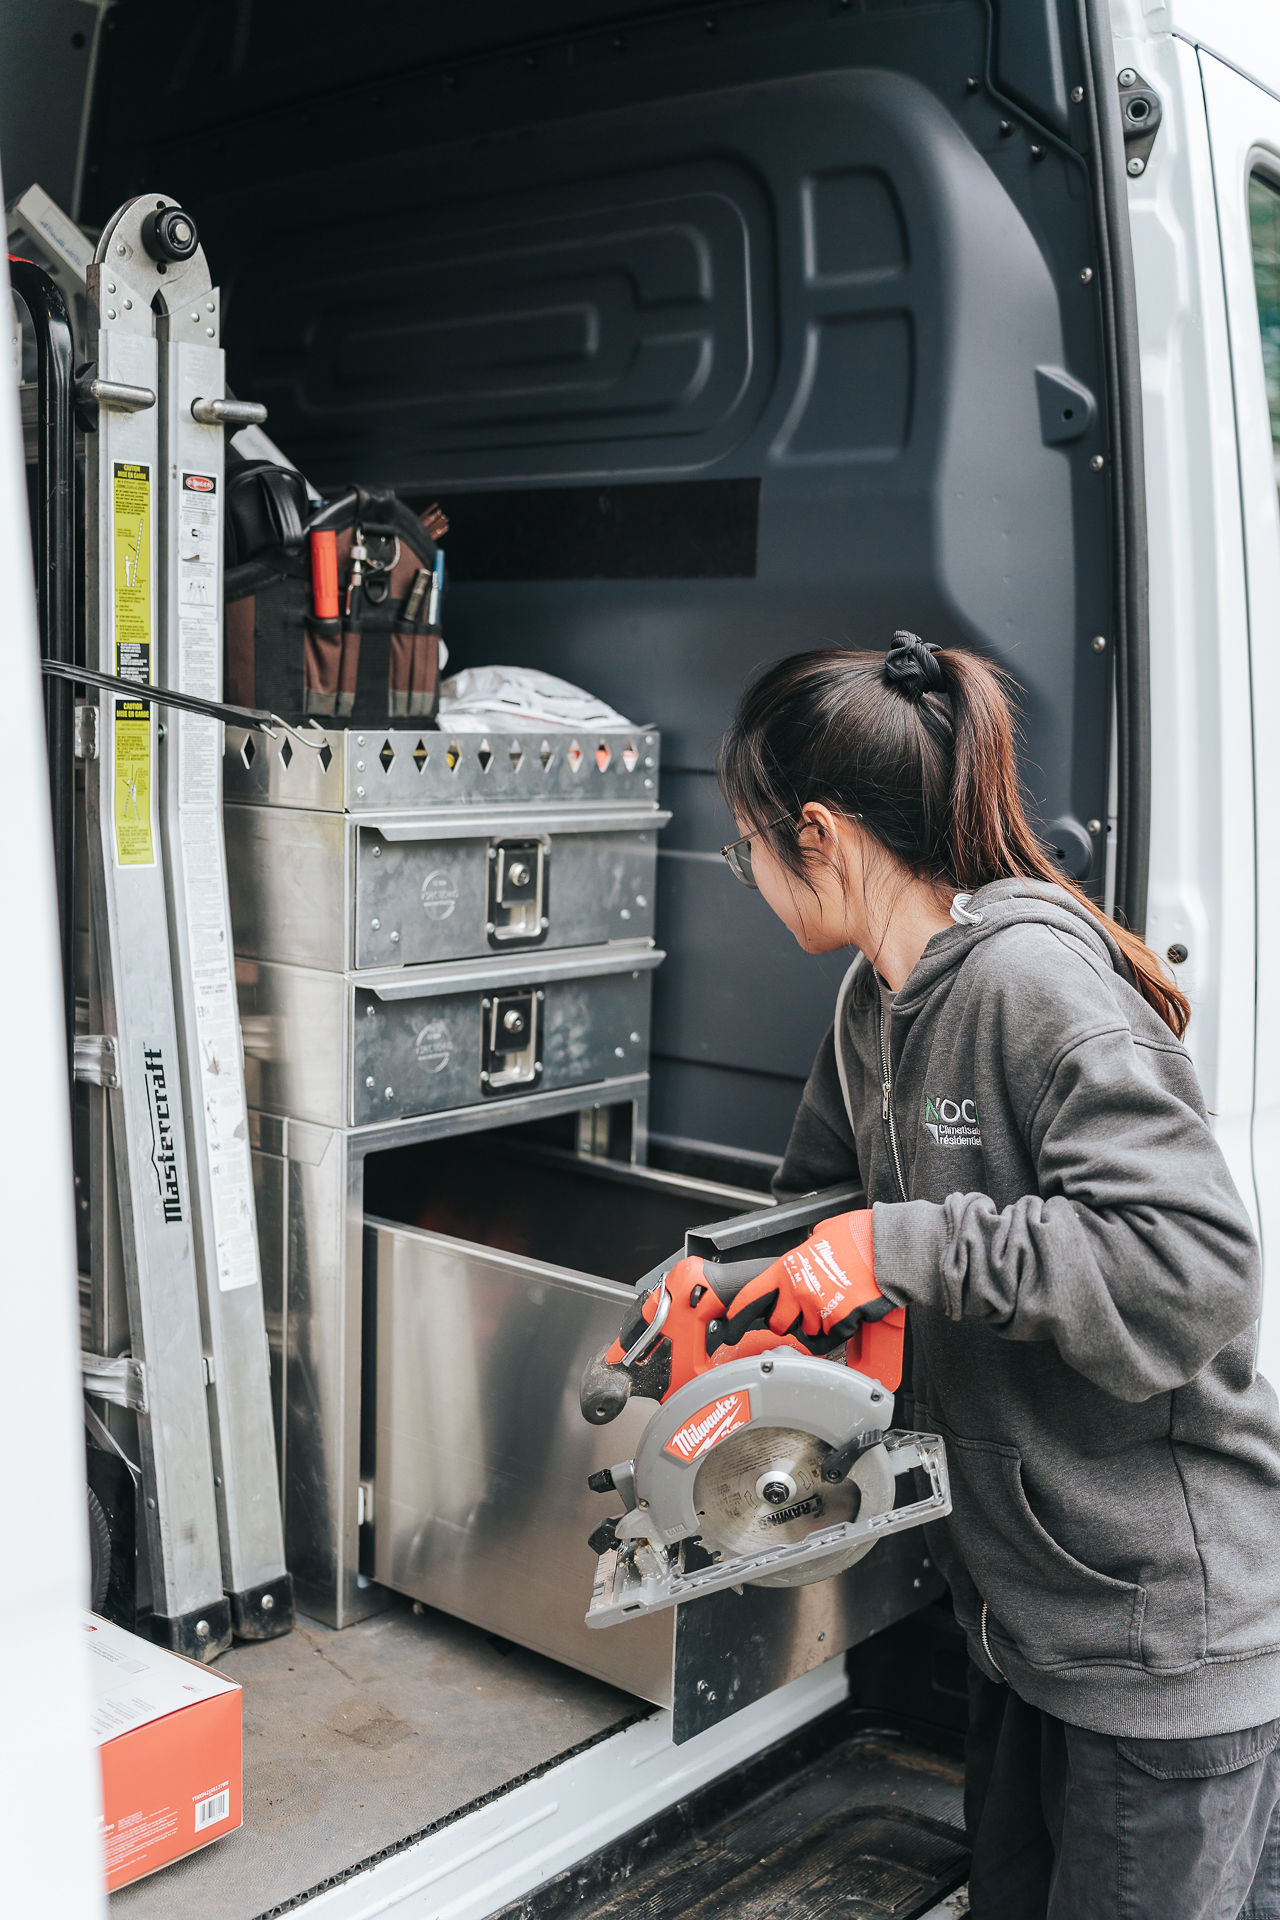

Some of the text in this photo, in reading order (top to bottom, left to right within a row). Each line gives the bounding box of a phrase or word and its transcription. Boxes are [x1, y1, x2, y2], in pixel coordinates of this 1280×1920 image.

[123, 702, 143, 710] CAUTION
[144, 1048, 183, 1224] Mastercraft
[814, 1239, 852, 1286] Milwaukee
[671, 1395, 738, 1456] Milwaukee
[720, 1421, 744, 1437] FUEL
